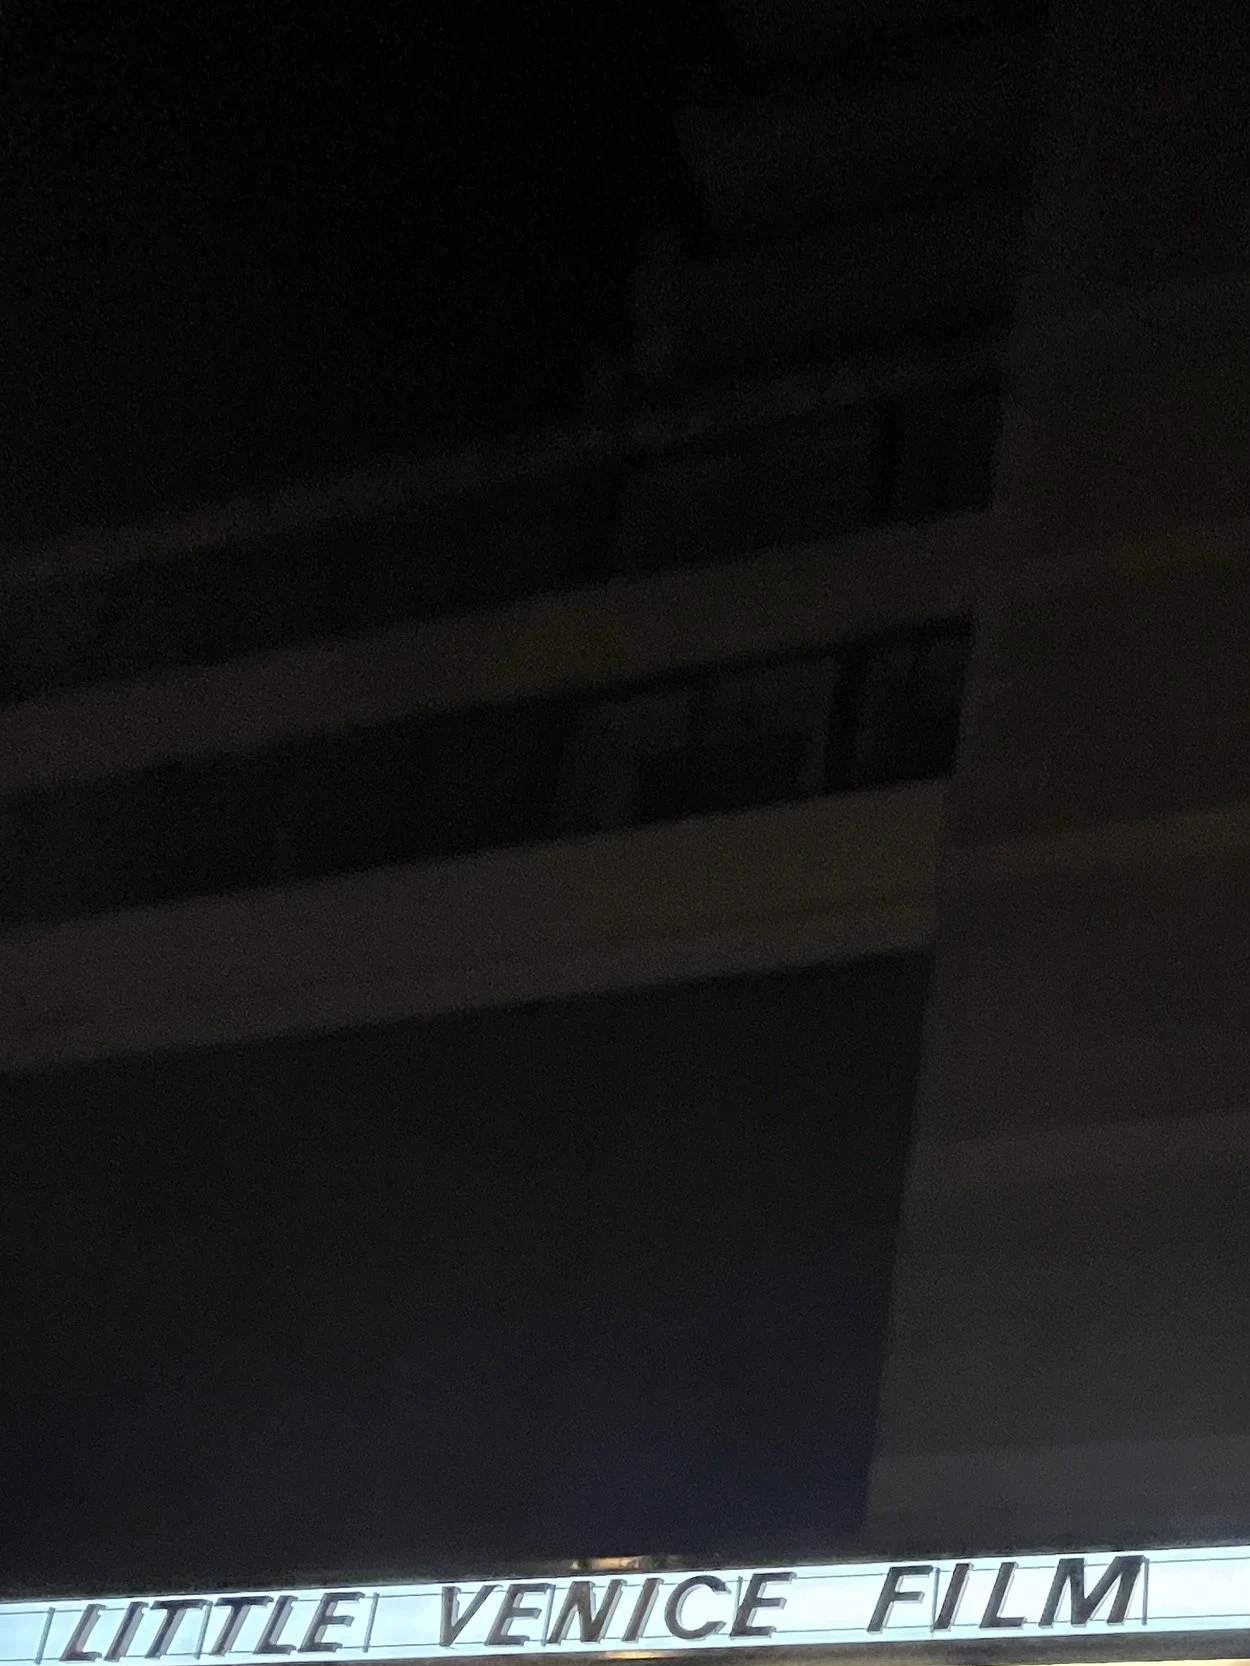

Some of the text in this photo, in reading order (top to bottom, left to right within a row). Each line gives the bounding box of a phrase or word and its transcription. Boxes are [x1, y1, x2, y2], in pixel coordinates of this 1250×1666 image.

[58, 1591, 365, 1663] LITTLE
[439, 1571, 797, 1648] VENICE
[866, 1555, 1146, 1634] FILM
